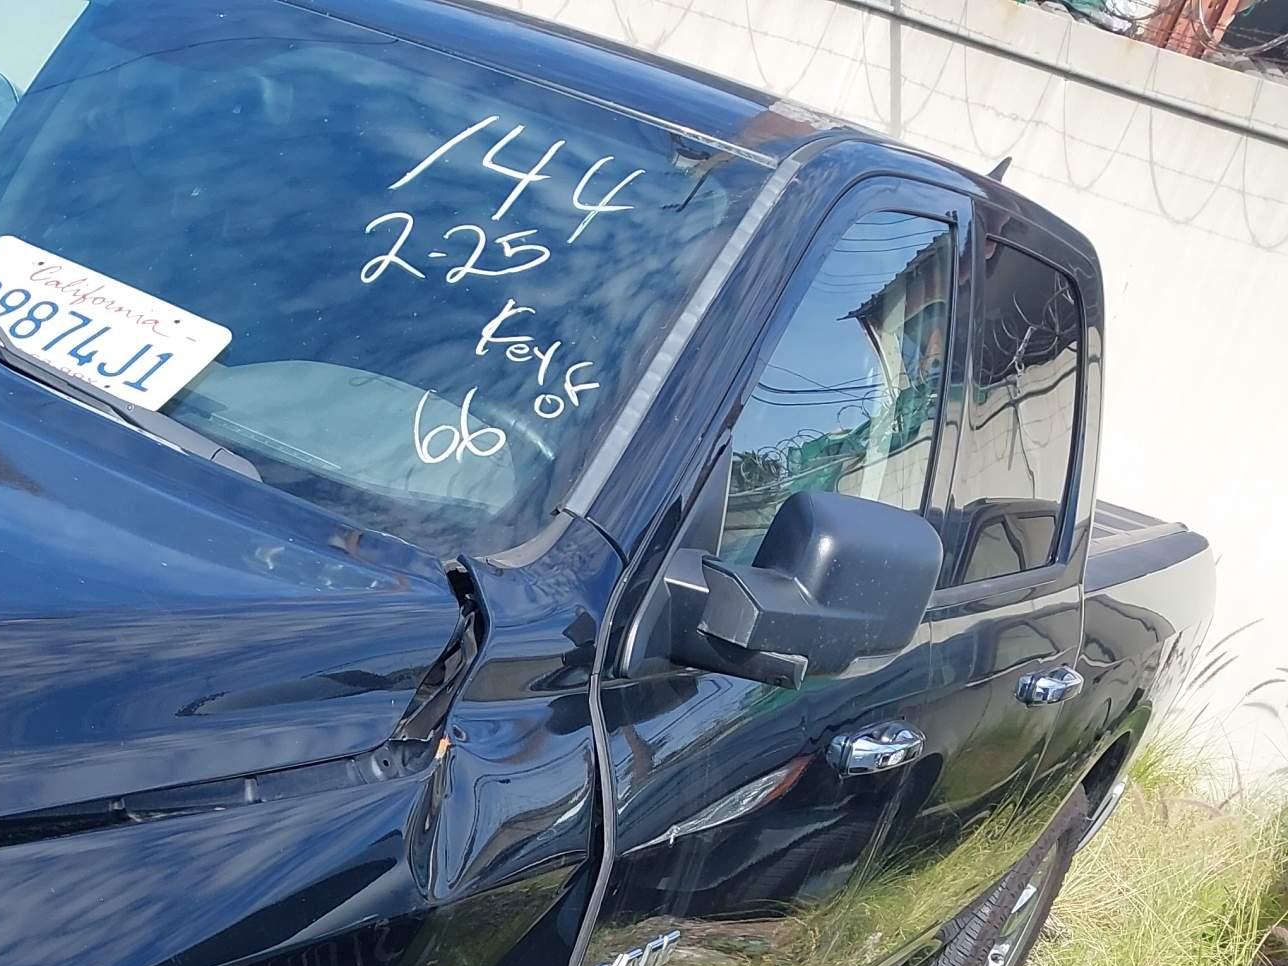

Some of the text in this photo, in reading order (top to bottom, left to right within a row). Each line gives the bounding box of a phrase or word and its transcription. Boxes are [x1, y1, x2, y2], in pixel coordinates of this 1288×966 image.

[387, 115, 646, 244] 144
[360, 212, 552, 284] 2-25
[29, 265, 168, 337] California
[413, 386, 507, 464] 66
